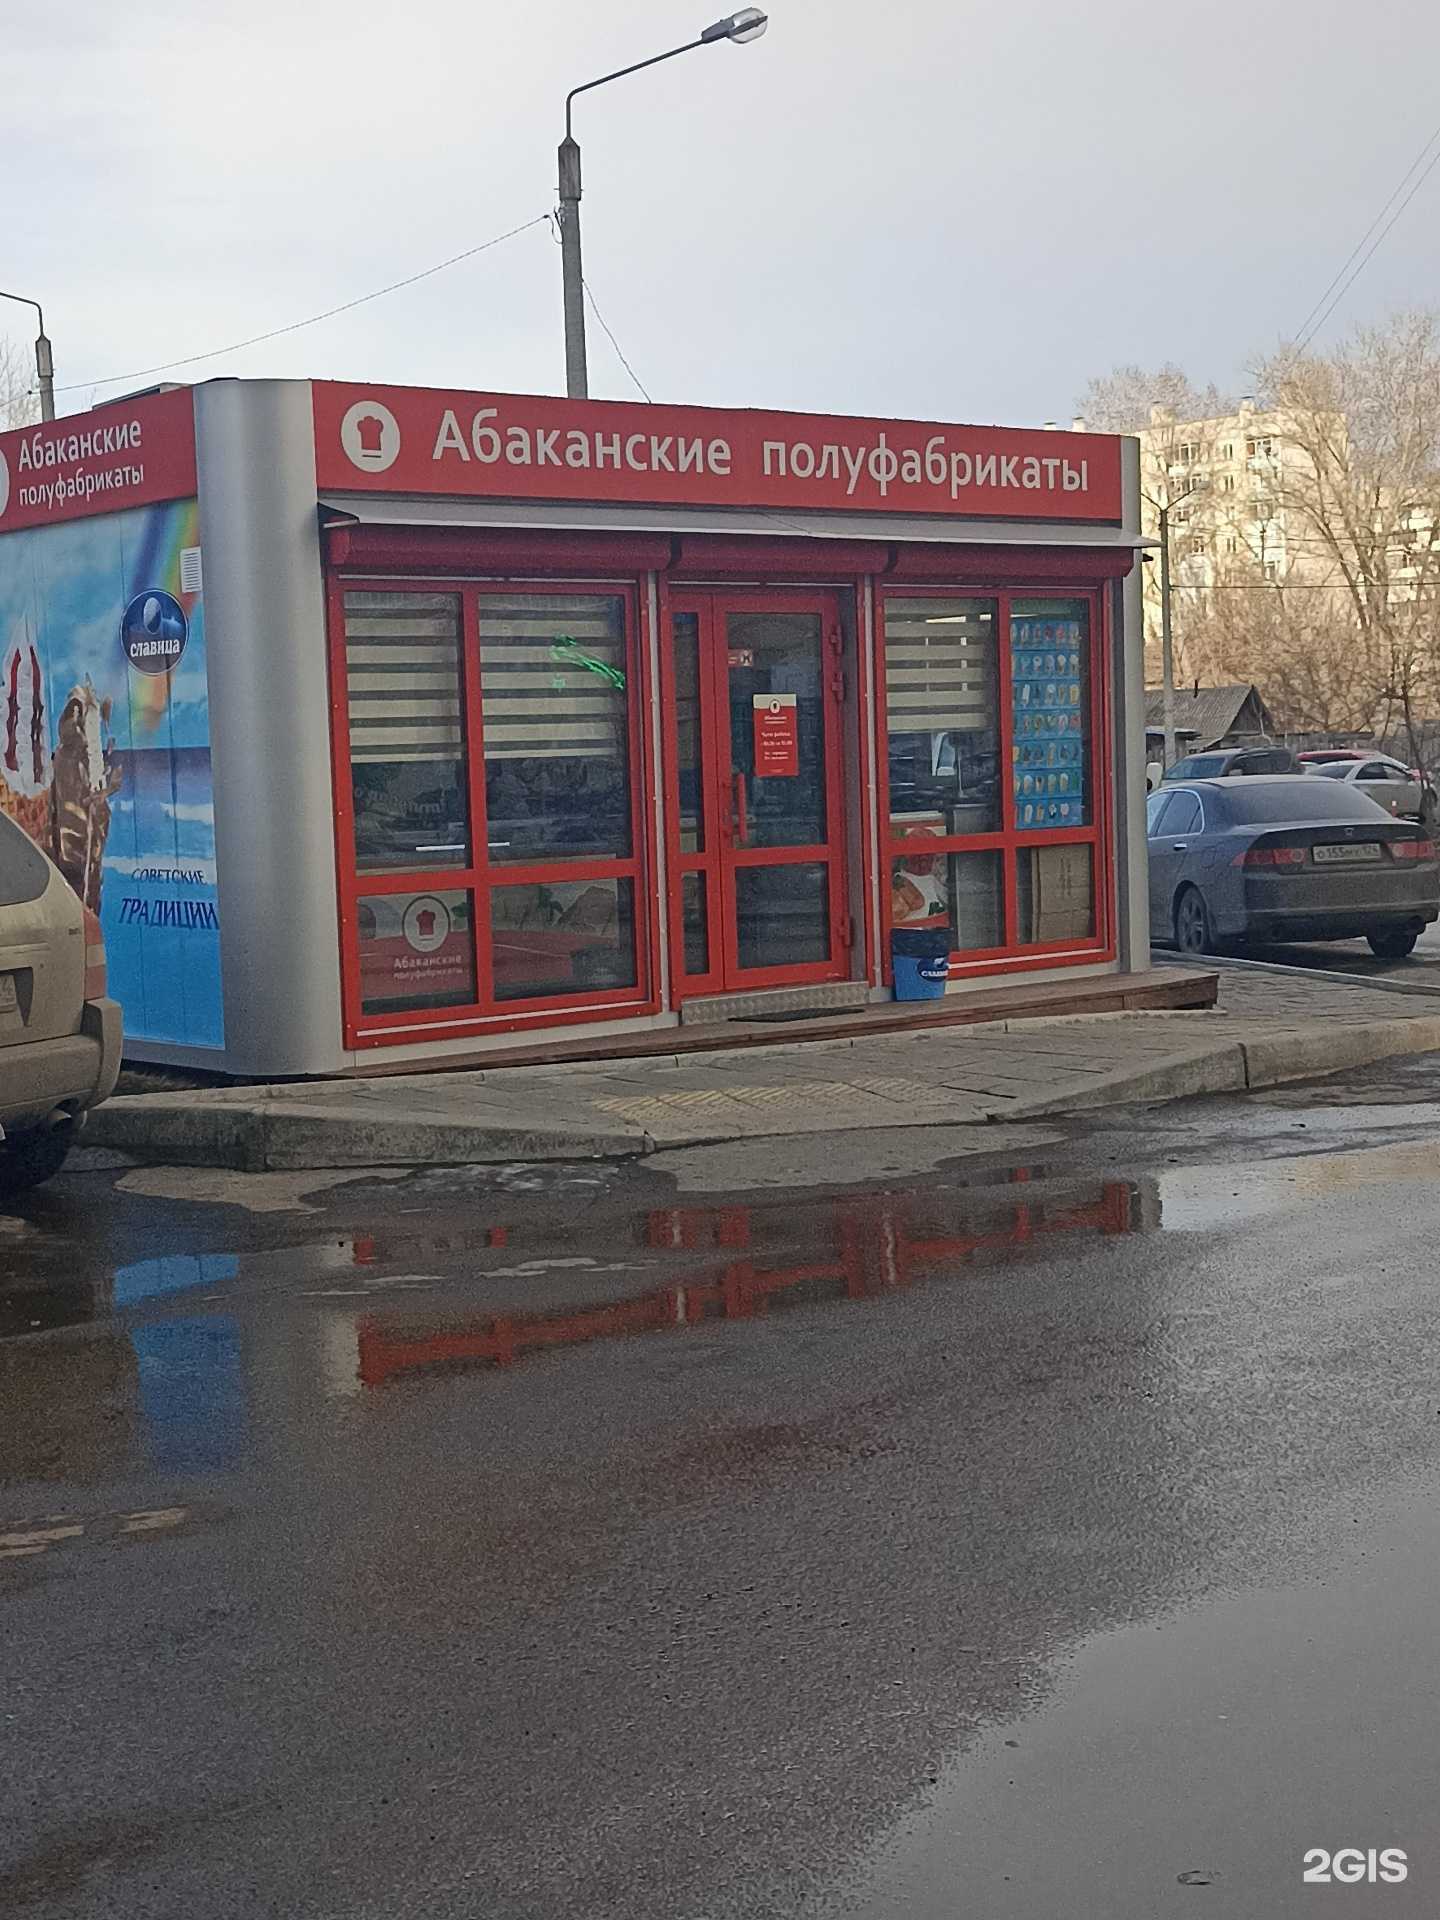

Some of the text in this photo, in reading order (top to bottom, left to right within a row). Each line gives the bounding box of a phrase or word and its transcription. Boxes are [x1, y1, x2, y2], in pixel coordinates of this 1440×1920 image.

[18, 420, 142, 472] Абаканские
[432, 408, 1088, 499] Абаканские полуфабрикаты
[19, 464, 144, 509] полуфабрикаты
[131, 868, 208, 885] СОВЕТСКИЕ
[118, 898, 220, 929] ТРАДИЦИИ
